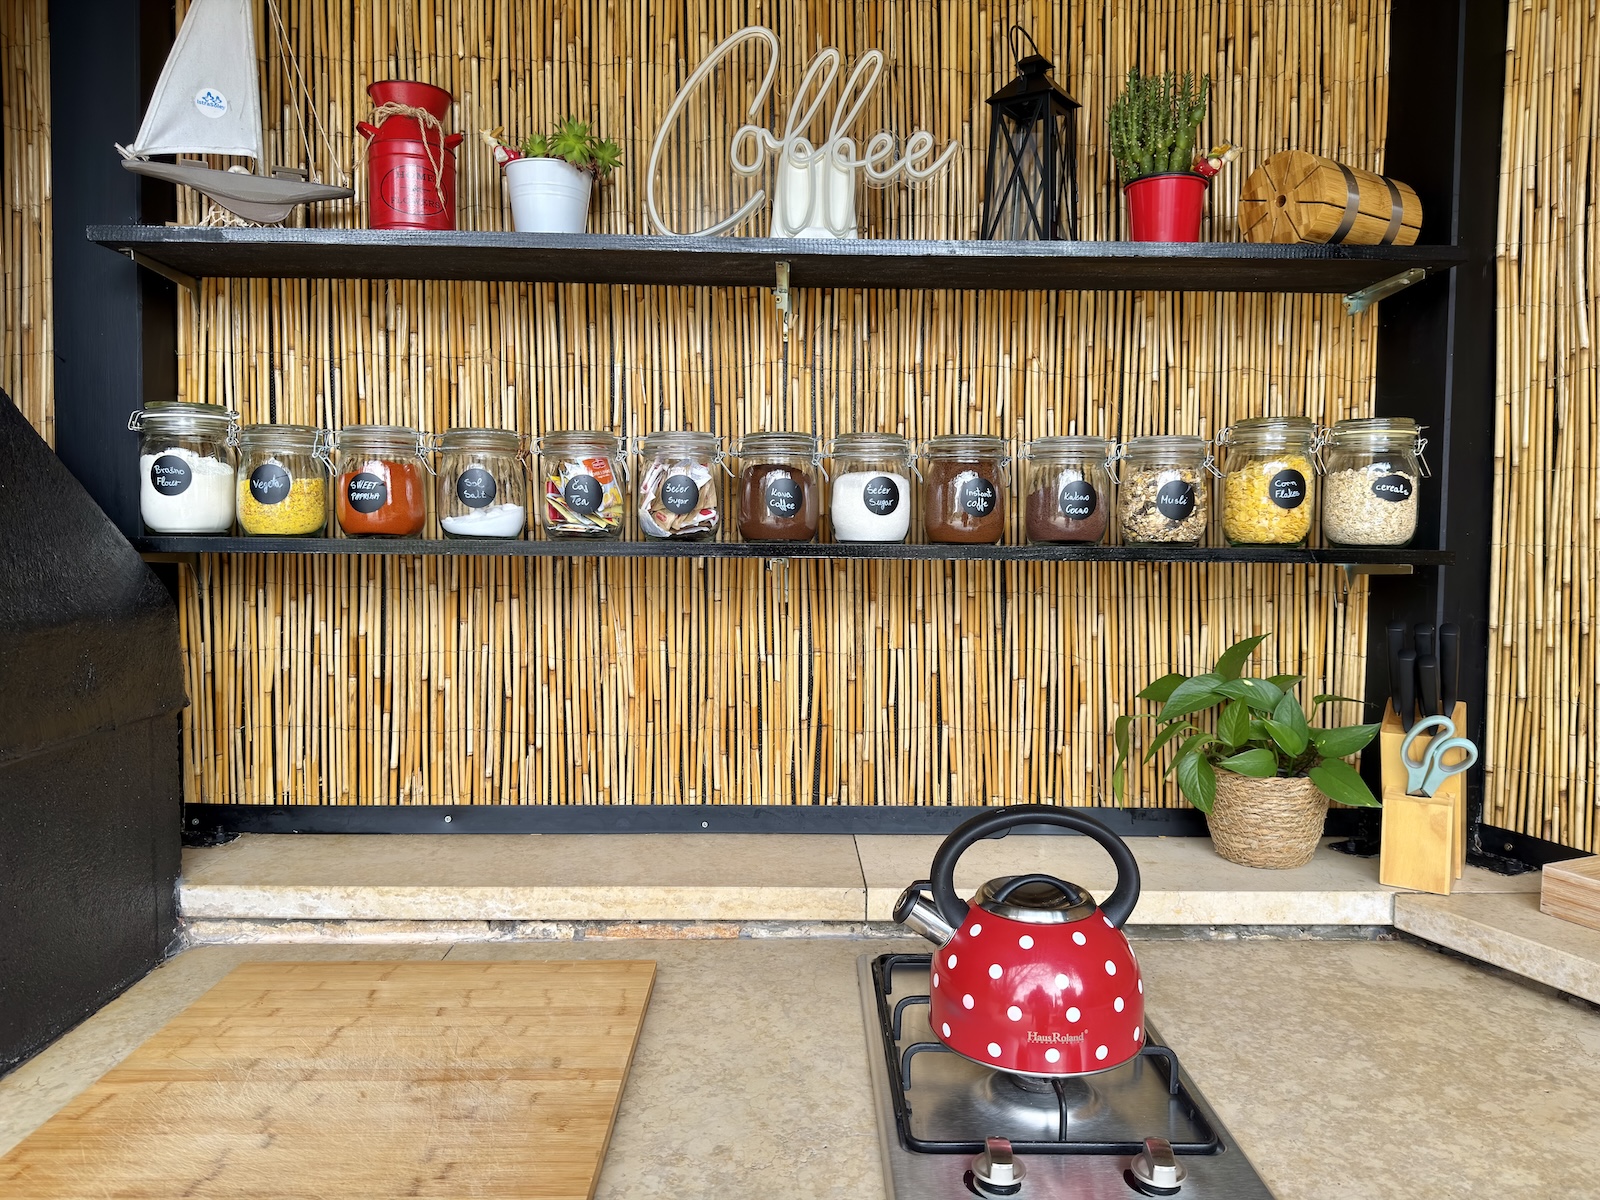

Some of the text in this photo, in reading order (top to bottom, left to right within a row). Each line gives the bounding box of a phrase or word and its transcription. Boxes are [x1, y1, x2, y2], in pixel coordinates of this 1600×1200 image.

[647, 25, 960, 238] Coffee
[396, 171, 435, 183] HOME
[391, 196, 441, 209] FLOWERS
[157, 476, 182, 486] Flour
[253, 474, 284, 493] Vegeta
[350, 480, 379, 490] SWEET
[464, 477, 485, 488] Sol
[571, 479, 589, 493] Čaj
[1274, 479, 1297, 488] Corn
[463, 490, 487, 499] Salt
[771, 487, 793, 498] Kava
[965, 486, 993, 497] Instant
[1275, 488, 1301, 498] Flakes
[1375, 484, 1409, 495] cereals
[570, 494, 589, 506] Tea
[1063, 491, 1090, 501] Kakao
[1160, 494, 1188, 505] Musli
[667, 496, 690, 508] Sugar
[769, 498, 796, 512] Coffee
[868, 498, 894, 511] Sugar
